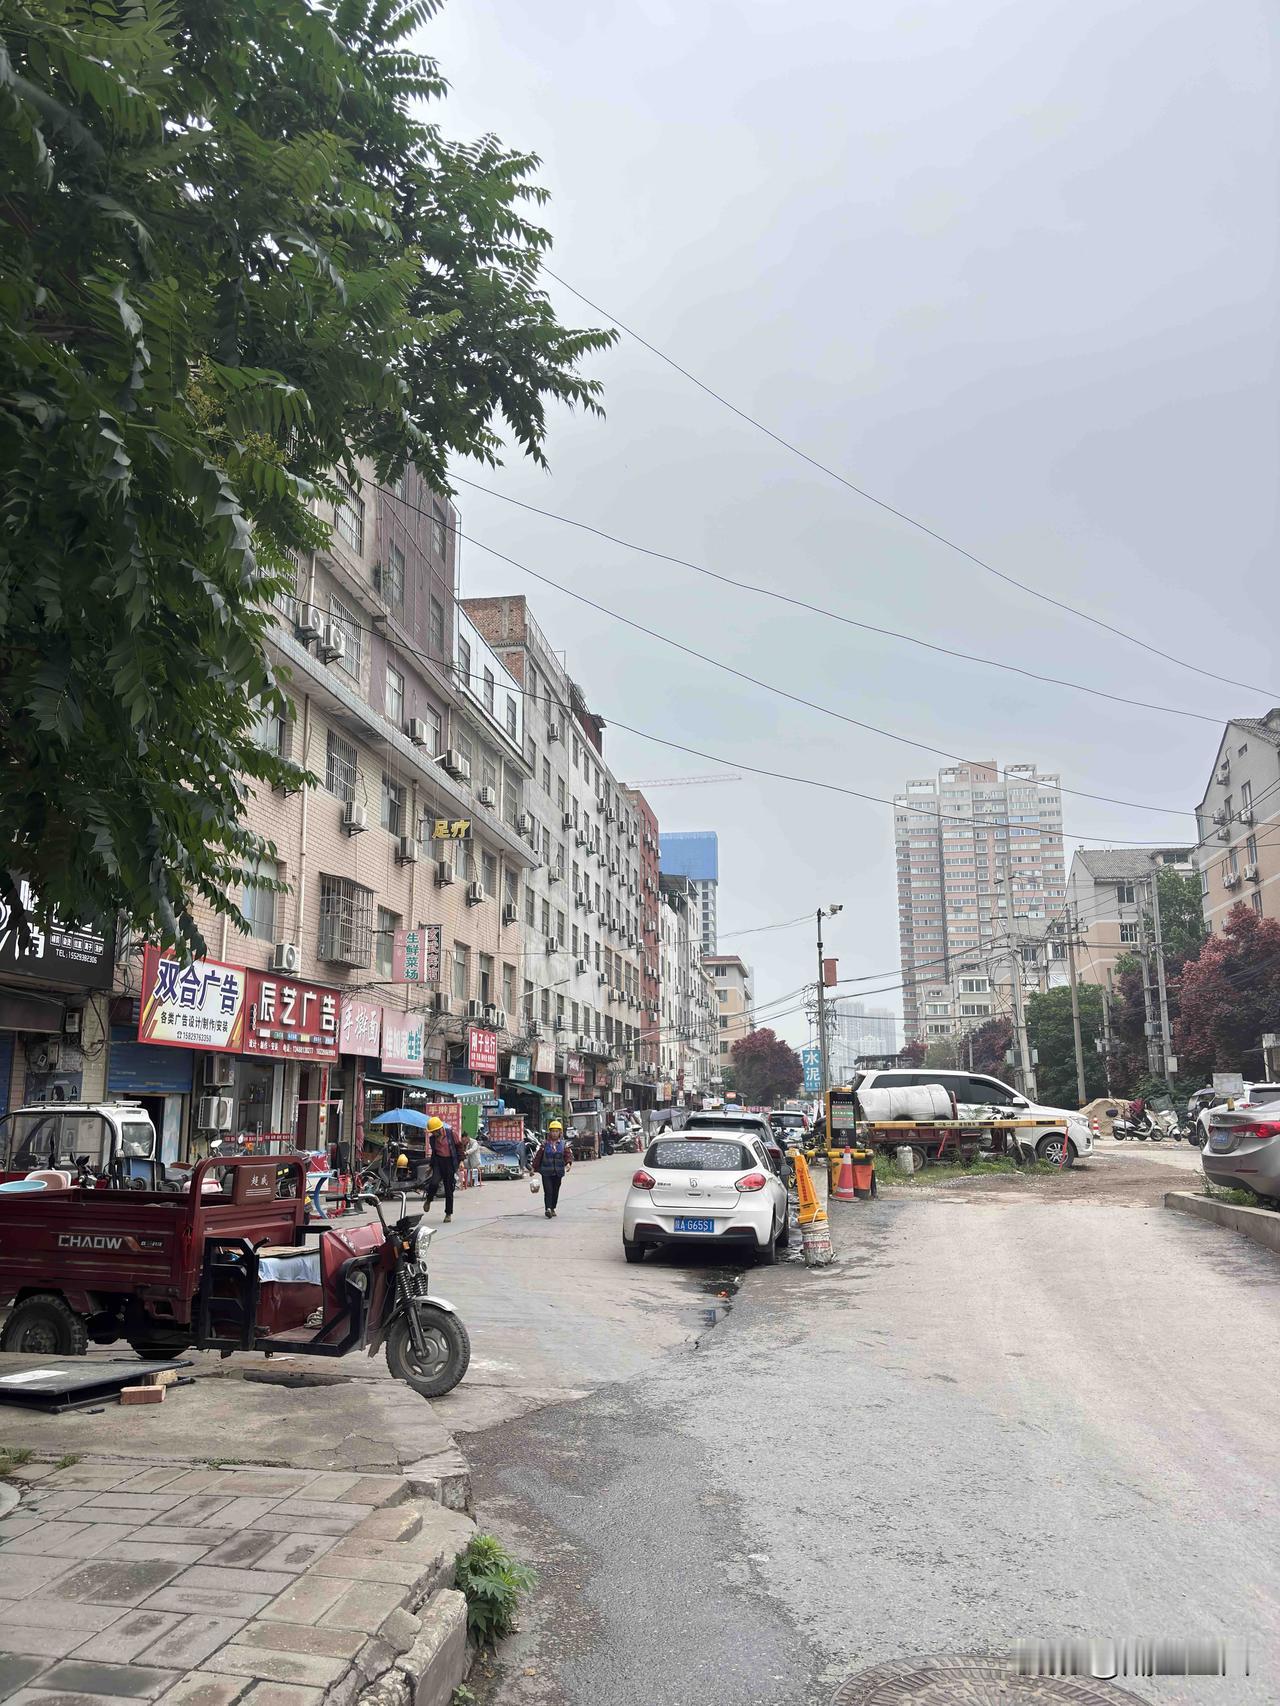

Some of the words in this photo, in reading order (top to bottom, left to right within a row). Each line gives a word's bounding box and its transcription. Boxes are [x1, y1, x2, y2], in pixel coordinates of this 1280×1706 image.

[432, 819, 471, 839] 足疗
[404, 932, 419, 980] 生鲜菜场
[153, 959, 240, 1015] 双合广告
[259, 981, 336, 1032] 辰艺广告
[804, 1050, 821, 1081] 水泥
